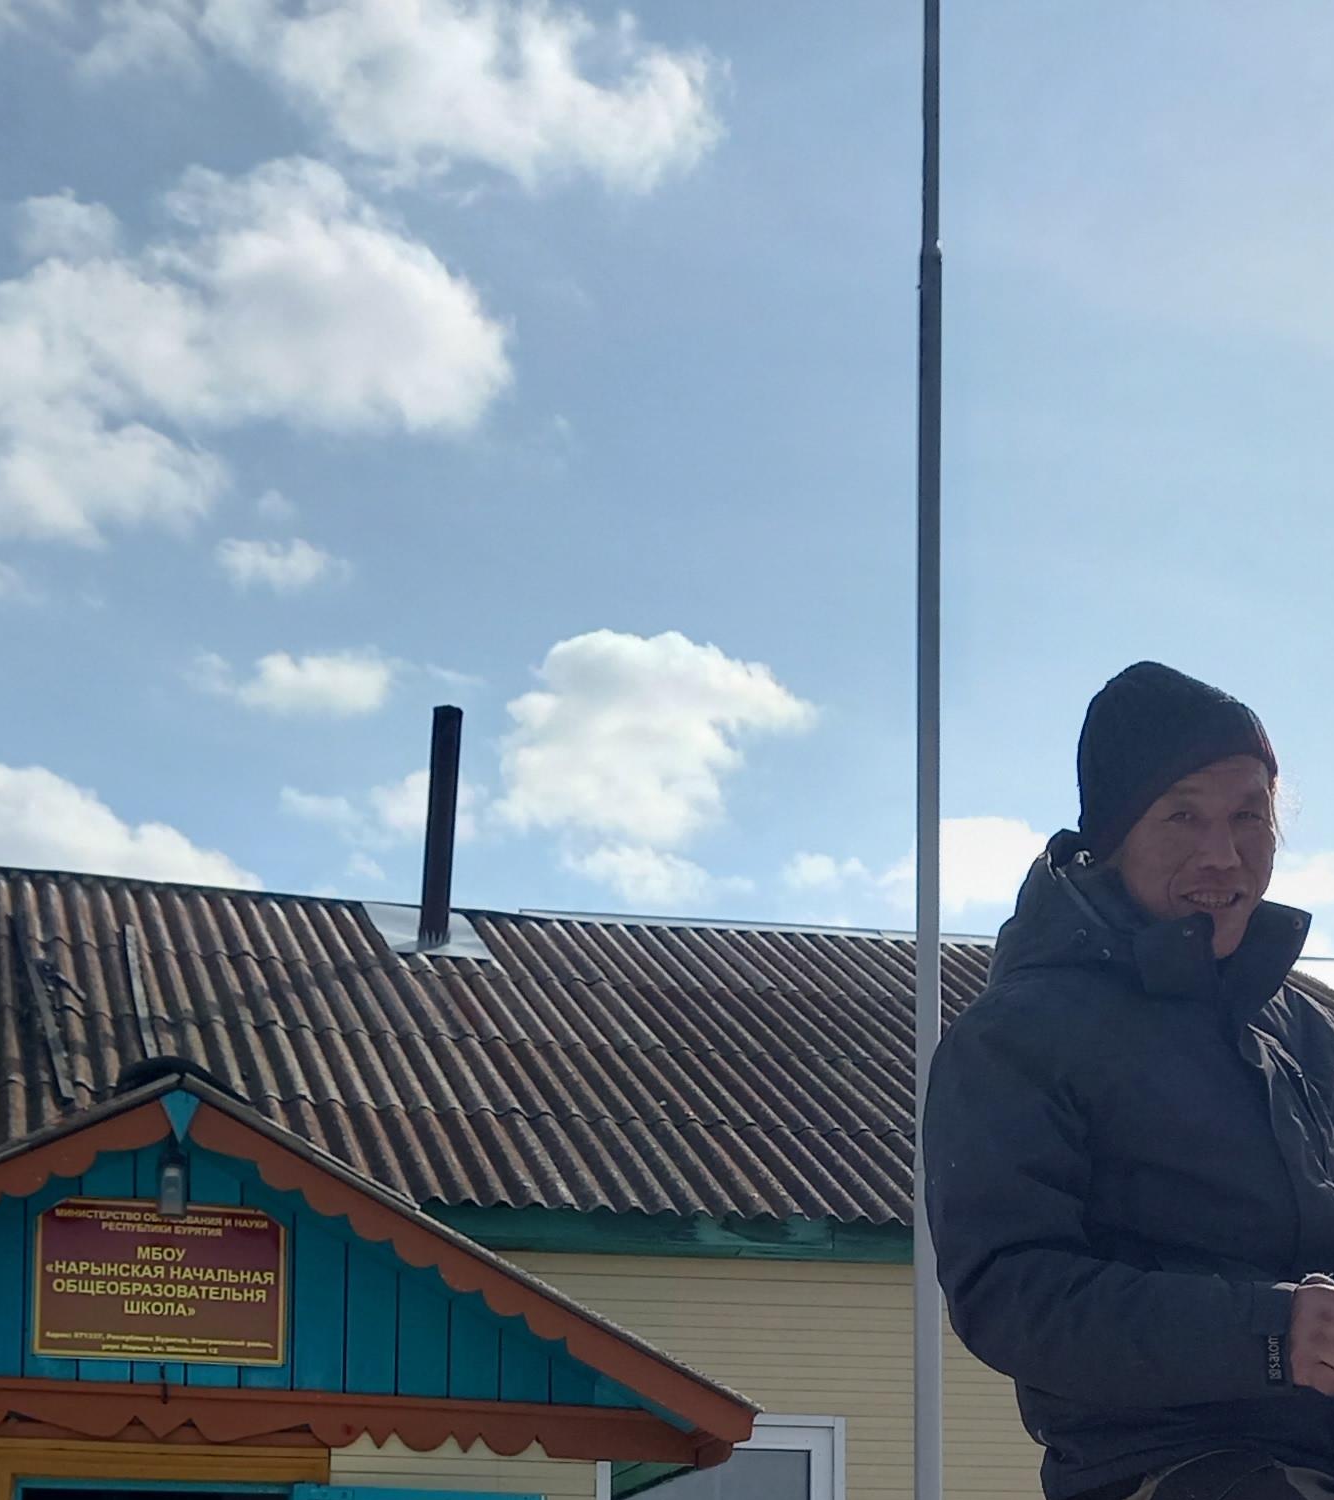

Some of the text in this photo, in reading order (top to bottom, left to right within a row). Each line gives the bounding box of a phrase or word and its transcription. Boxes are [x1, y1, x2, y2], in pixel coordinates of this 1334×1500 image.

[55, 1208, 269, 1229] МИНИСТЕРСТВО ОБВАНИЯ И НАУКИ
[101, 1221, 223, 1237] РЕСПУБЛИКИ БУРЯТИЯ
[137, 1246, 186, 1262] МБОУ
[45, 1260, 275, 1285] «НАРЫНСКАЯ НАЧАЛЬНАЯ
[52, 1278, 267, 1303] ОБЩЕОБРАЗОВАТЕЛЬНЯ
[124, 1300, 196, 1316] ШКОЛА»
